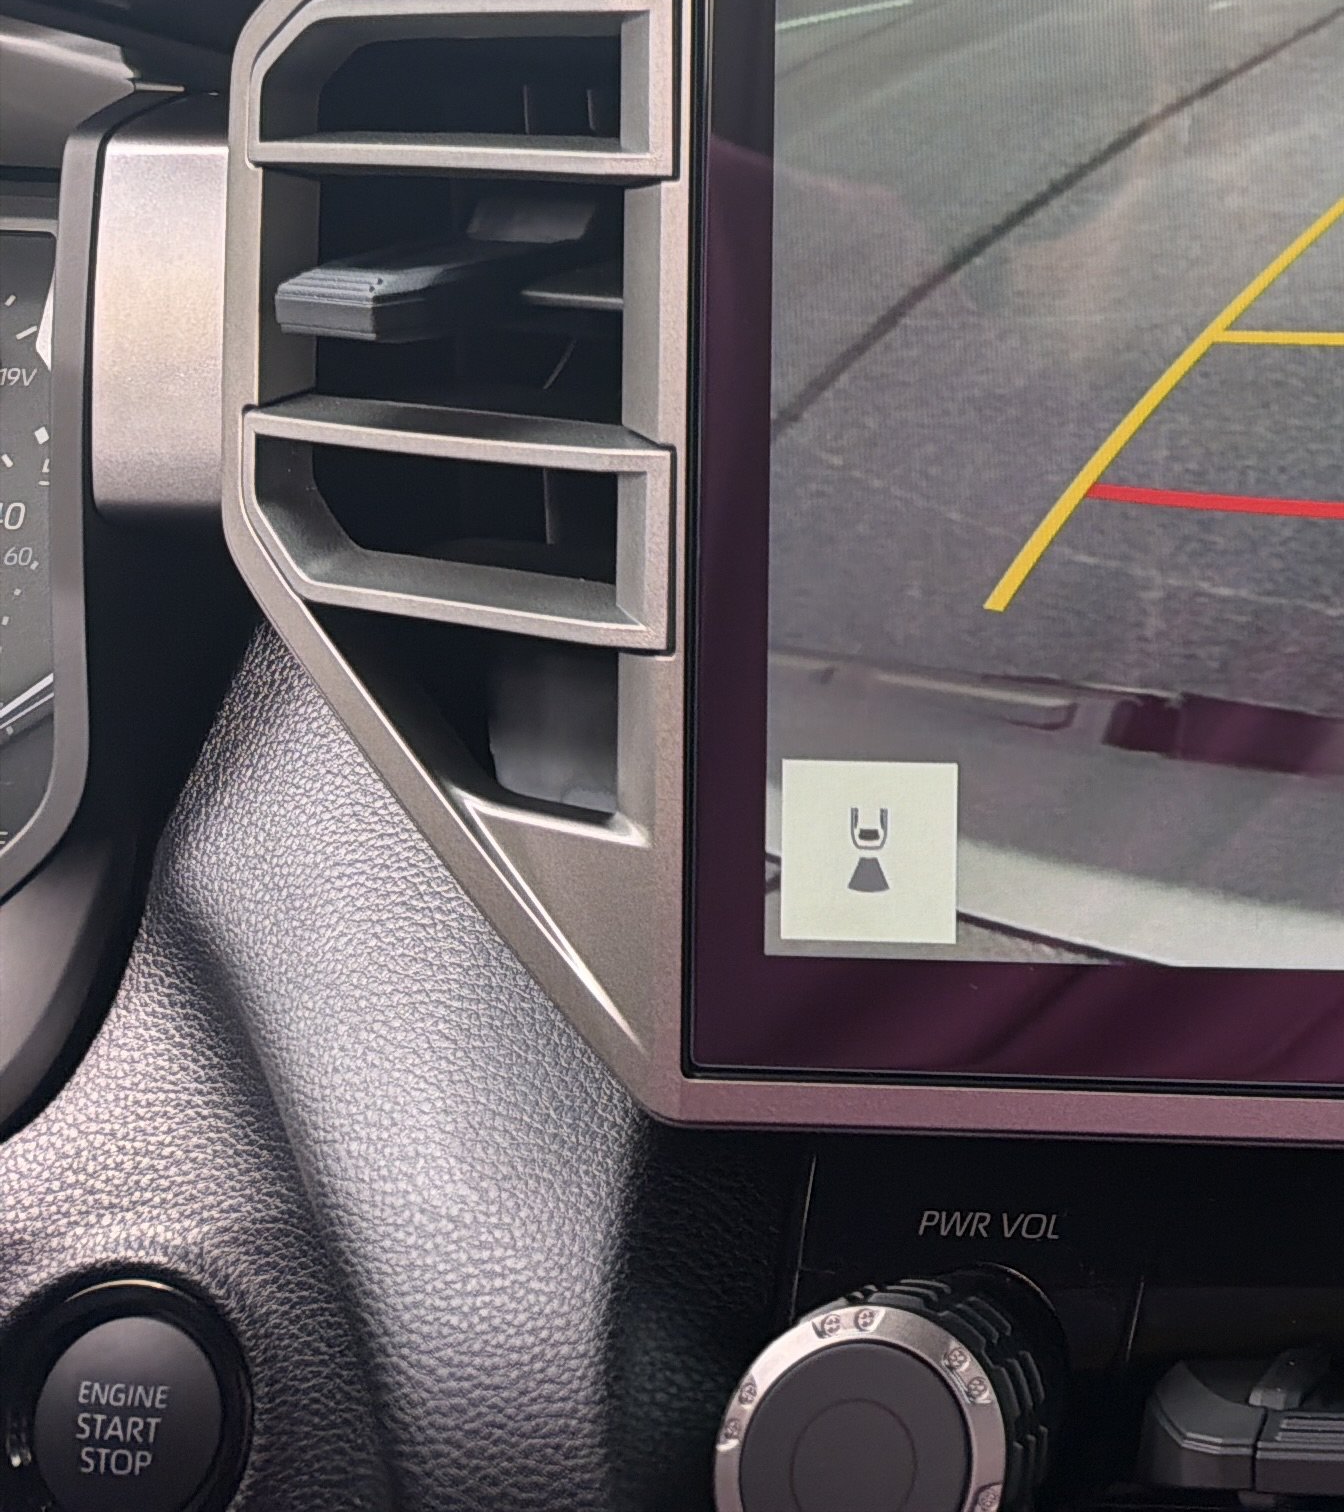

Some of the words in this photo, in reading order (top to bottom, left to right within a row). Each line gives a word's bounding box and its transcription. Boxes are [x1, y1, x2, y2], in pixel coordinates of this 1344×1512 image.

[0, 501, 26, 531] 0
[4, 546, 33, 567] 60
[917, 1210, 990, 1239] PWR
[1002, 1212, 1061, 1240] VOL
[78, 1380, 169, 1410] ENGINE
[75, 1413, 162, 1444] START
[80, 1447, 153, 1476] STOP
